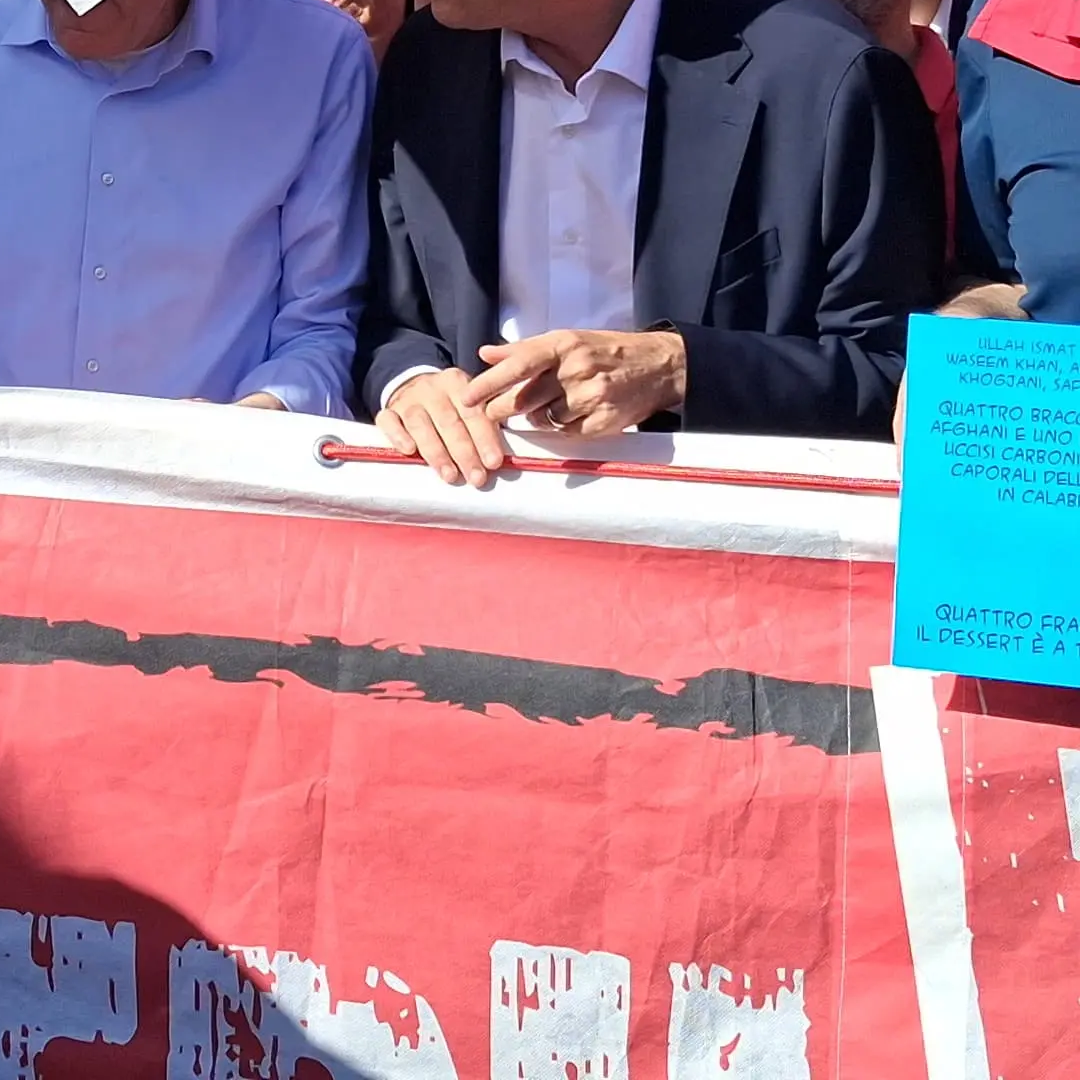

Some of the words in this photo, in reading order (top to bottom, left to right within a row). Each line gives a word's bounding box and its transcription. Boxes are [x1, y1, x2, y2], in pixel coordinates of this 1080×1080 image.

[978, 337, 1024, 351] ULLAH
[1031, 341, 1076, 356] ISMAT
[946, 353, 1009, 369] WASEEM
[1015, 358, 1062, 376] KHAN,
[959, 372, 1046, 392] KHOGJANI,
[938, 400, 1024, 421] QUATTRO
[930, 420, 1008, 439] AFGHANI
[1015, 427, 1026, 441] E
[1033, 428, 1072, 445] UNO
[944, 441, 995, 459] UCCISI
[951, 463, 1037, 483] CAPORALI
[998, 487, 1015, 502] IN
[1022, 489, 1080, 508] CALAB
[935, 604, 1033, 629] QUATTRO
[916, 624, 931, 642] IL
[939, 628, 1025, 653] DESSERT
[1032, 632, 1045, 654] È
[1053, 639, 1065, 655] A
